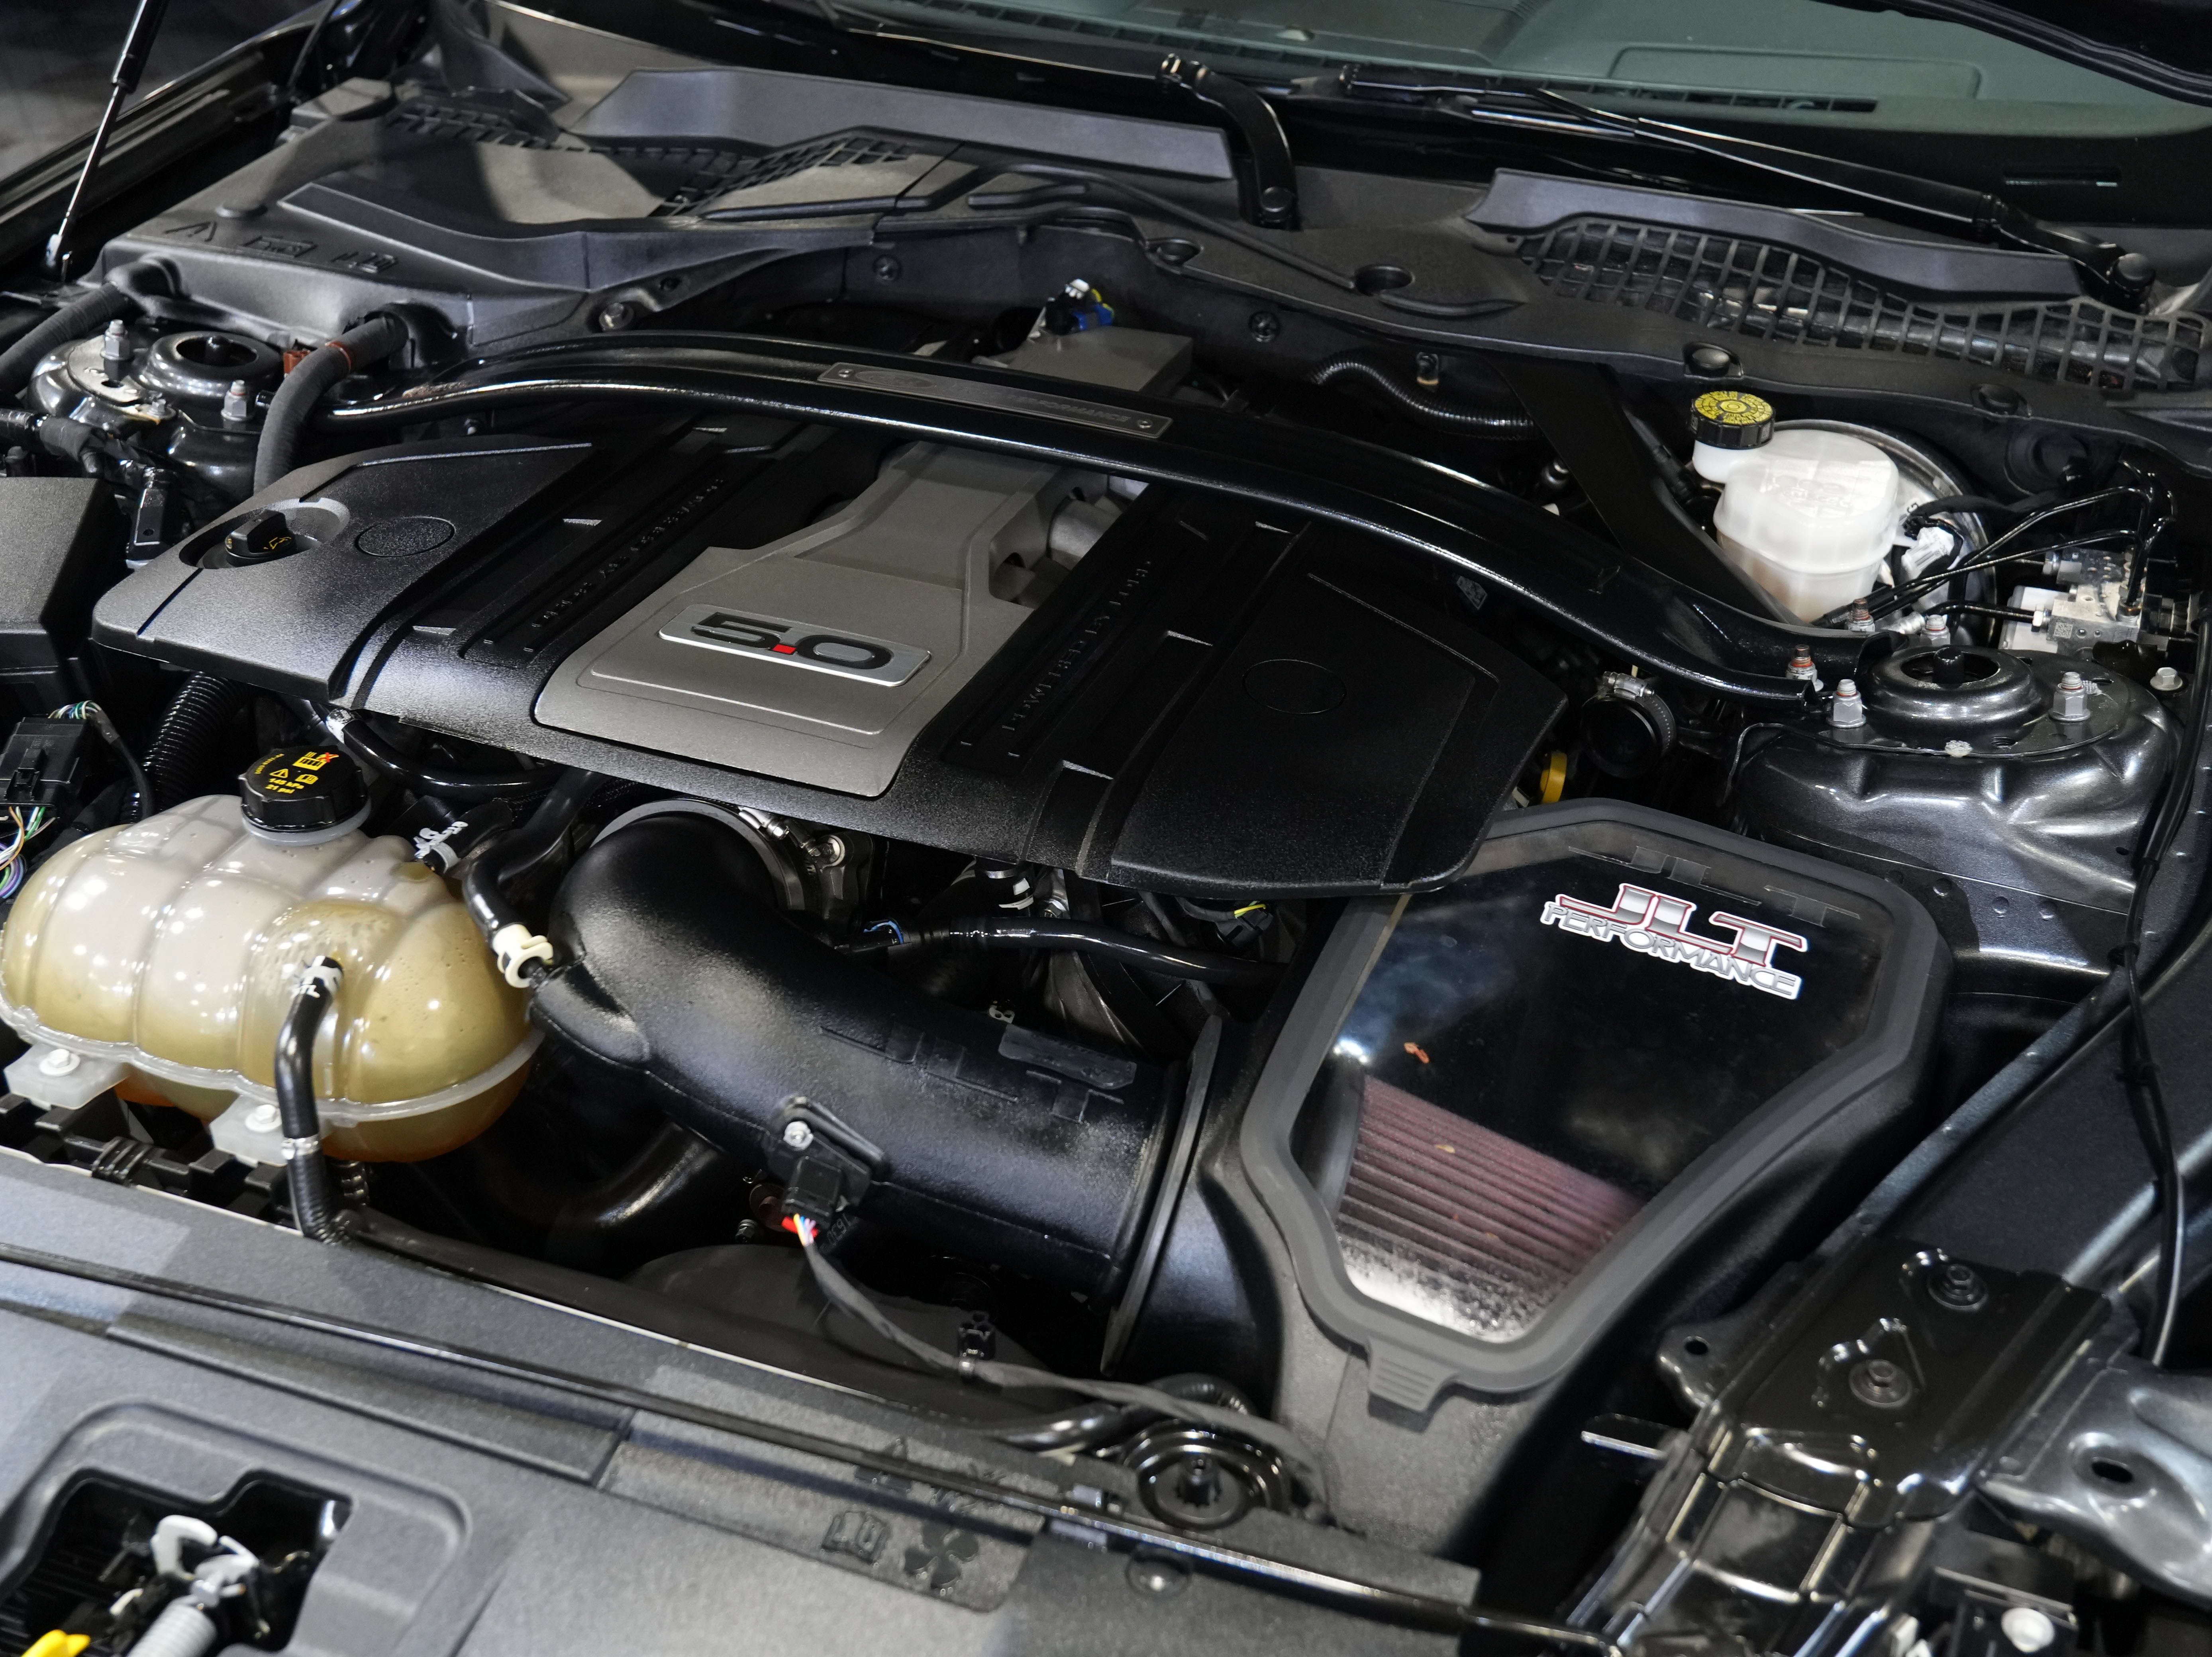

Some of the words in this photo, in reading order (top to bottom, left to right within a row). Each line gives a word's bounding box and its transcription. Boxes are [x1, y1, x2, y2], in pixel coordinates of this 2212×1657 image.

[691, 611, 895, 670] 5.0
[1543, 902, 1797, 997] PERFORMANCE
[1559, 884, 1804, 968] JLT
